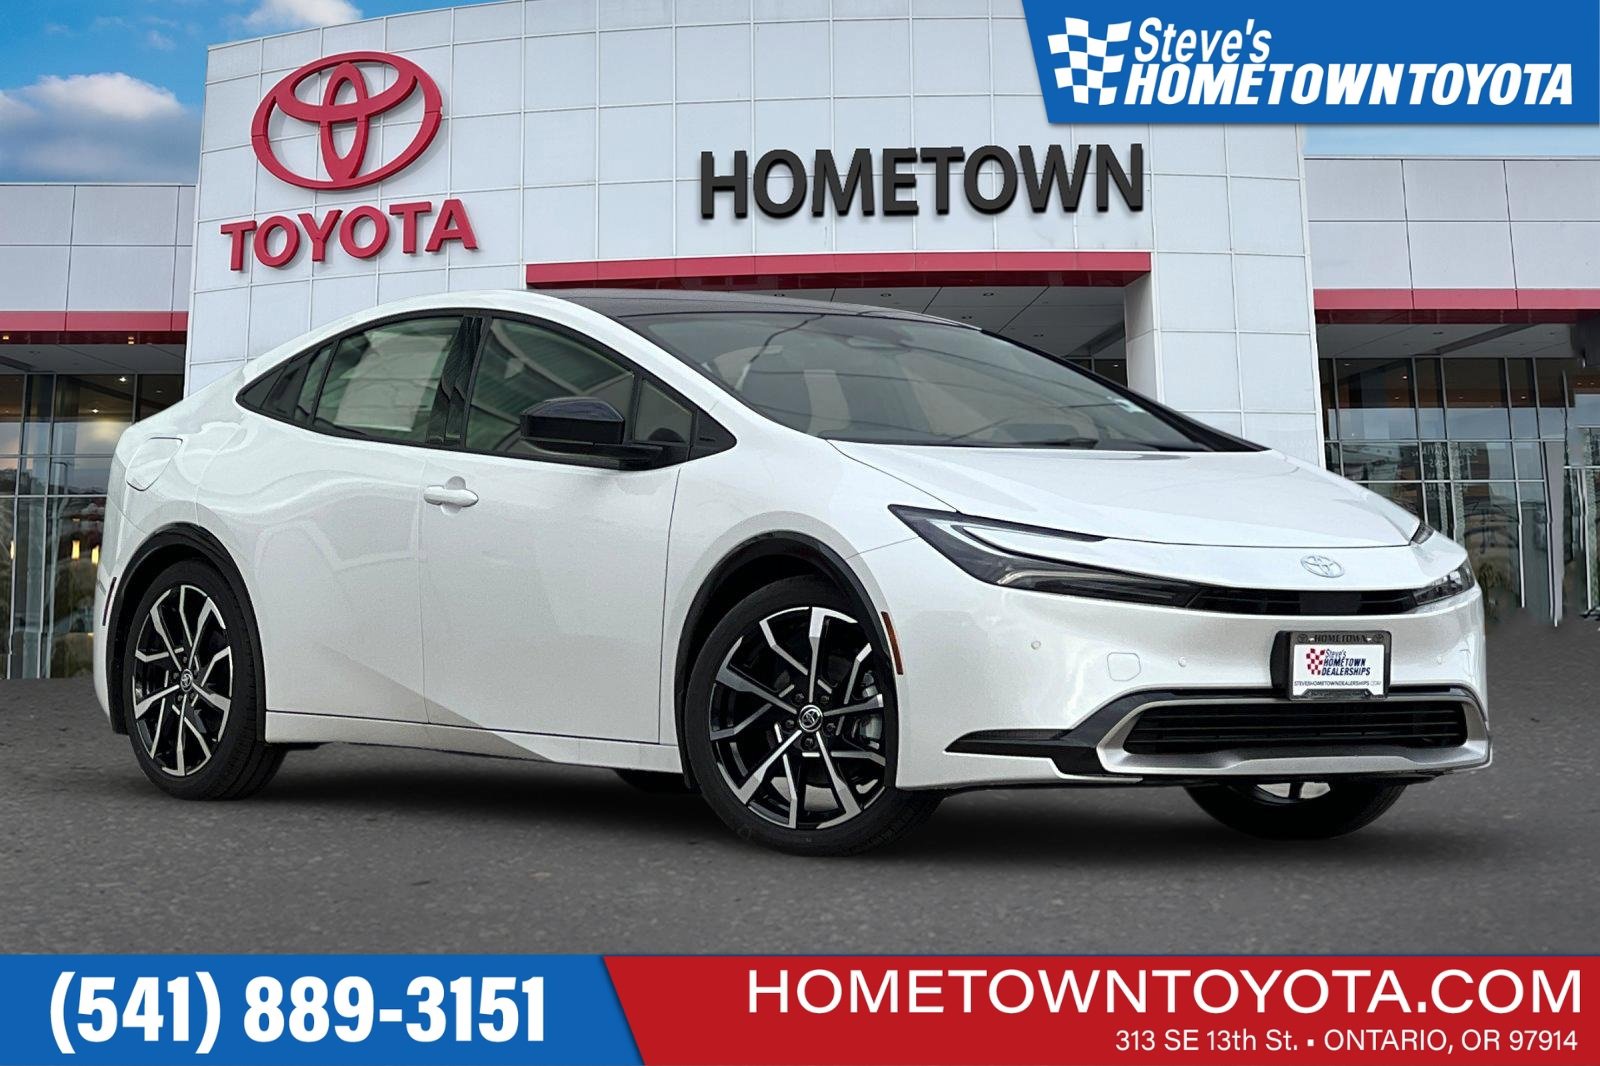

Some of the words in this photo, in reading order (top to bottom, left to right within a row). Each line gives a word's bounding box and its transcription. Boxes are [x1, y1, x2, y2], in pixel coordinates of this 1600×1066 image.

[701, 144, 1145, 219] HOMETOWN
[221, 199, 478, 271] TOYOTA
[1314, 634, 1368, 643] HOMETOWN
[1325, 648, 1347, 659] Steve's
[1323, 658, 1367, 667] HOMETOWN
[1321, 667, 1371, 676] DEALERSHIPS
